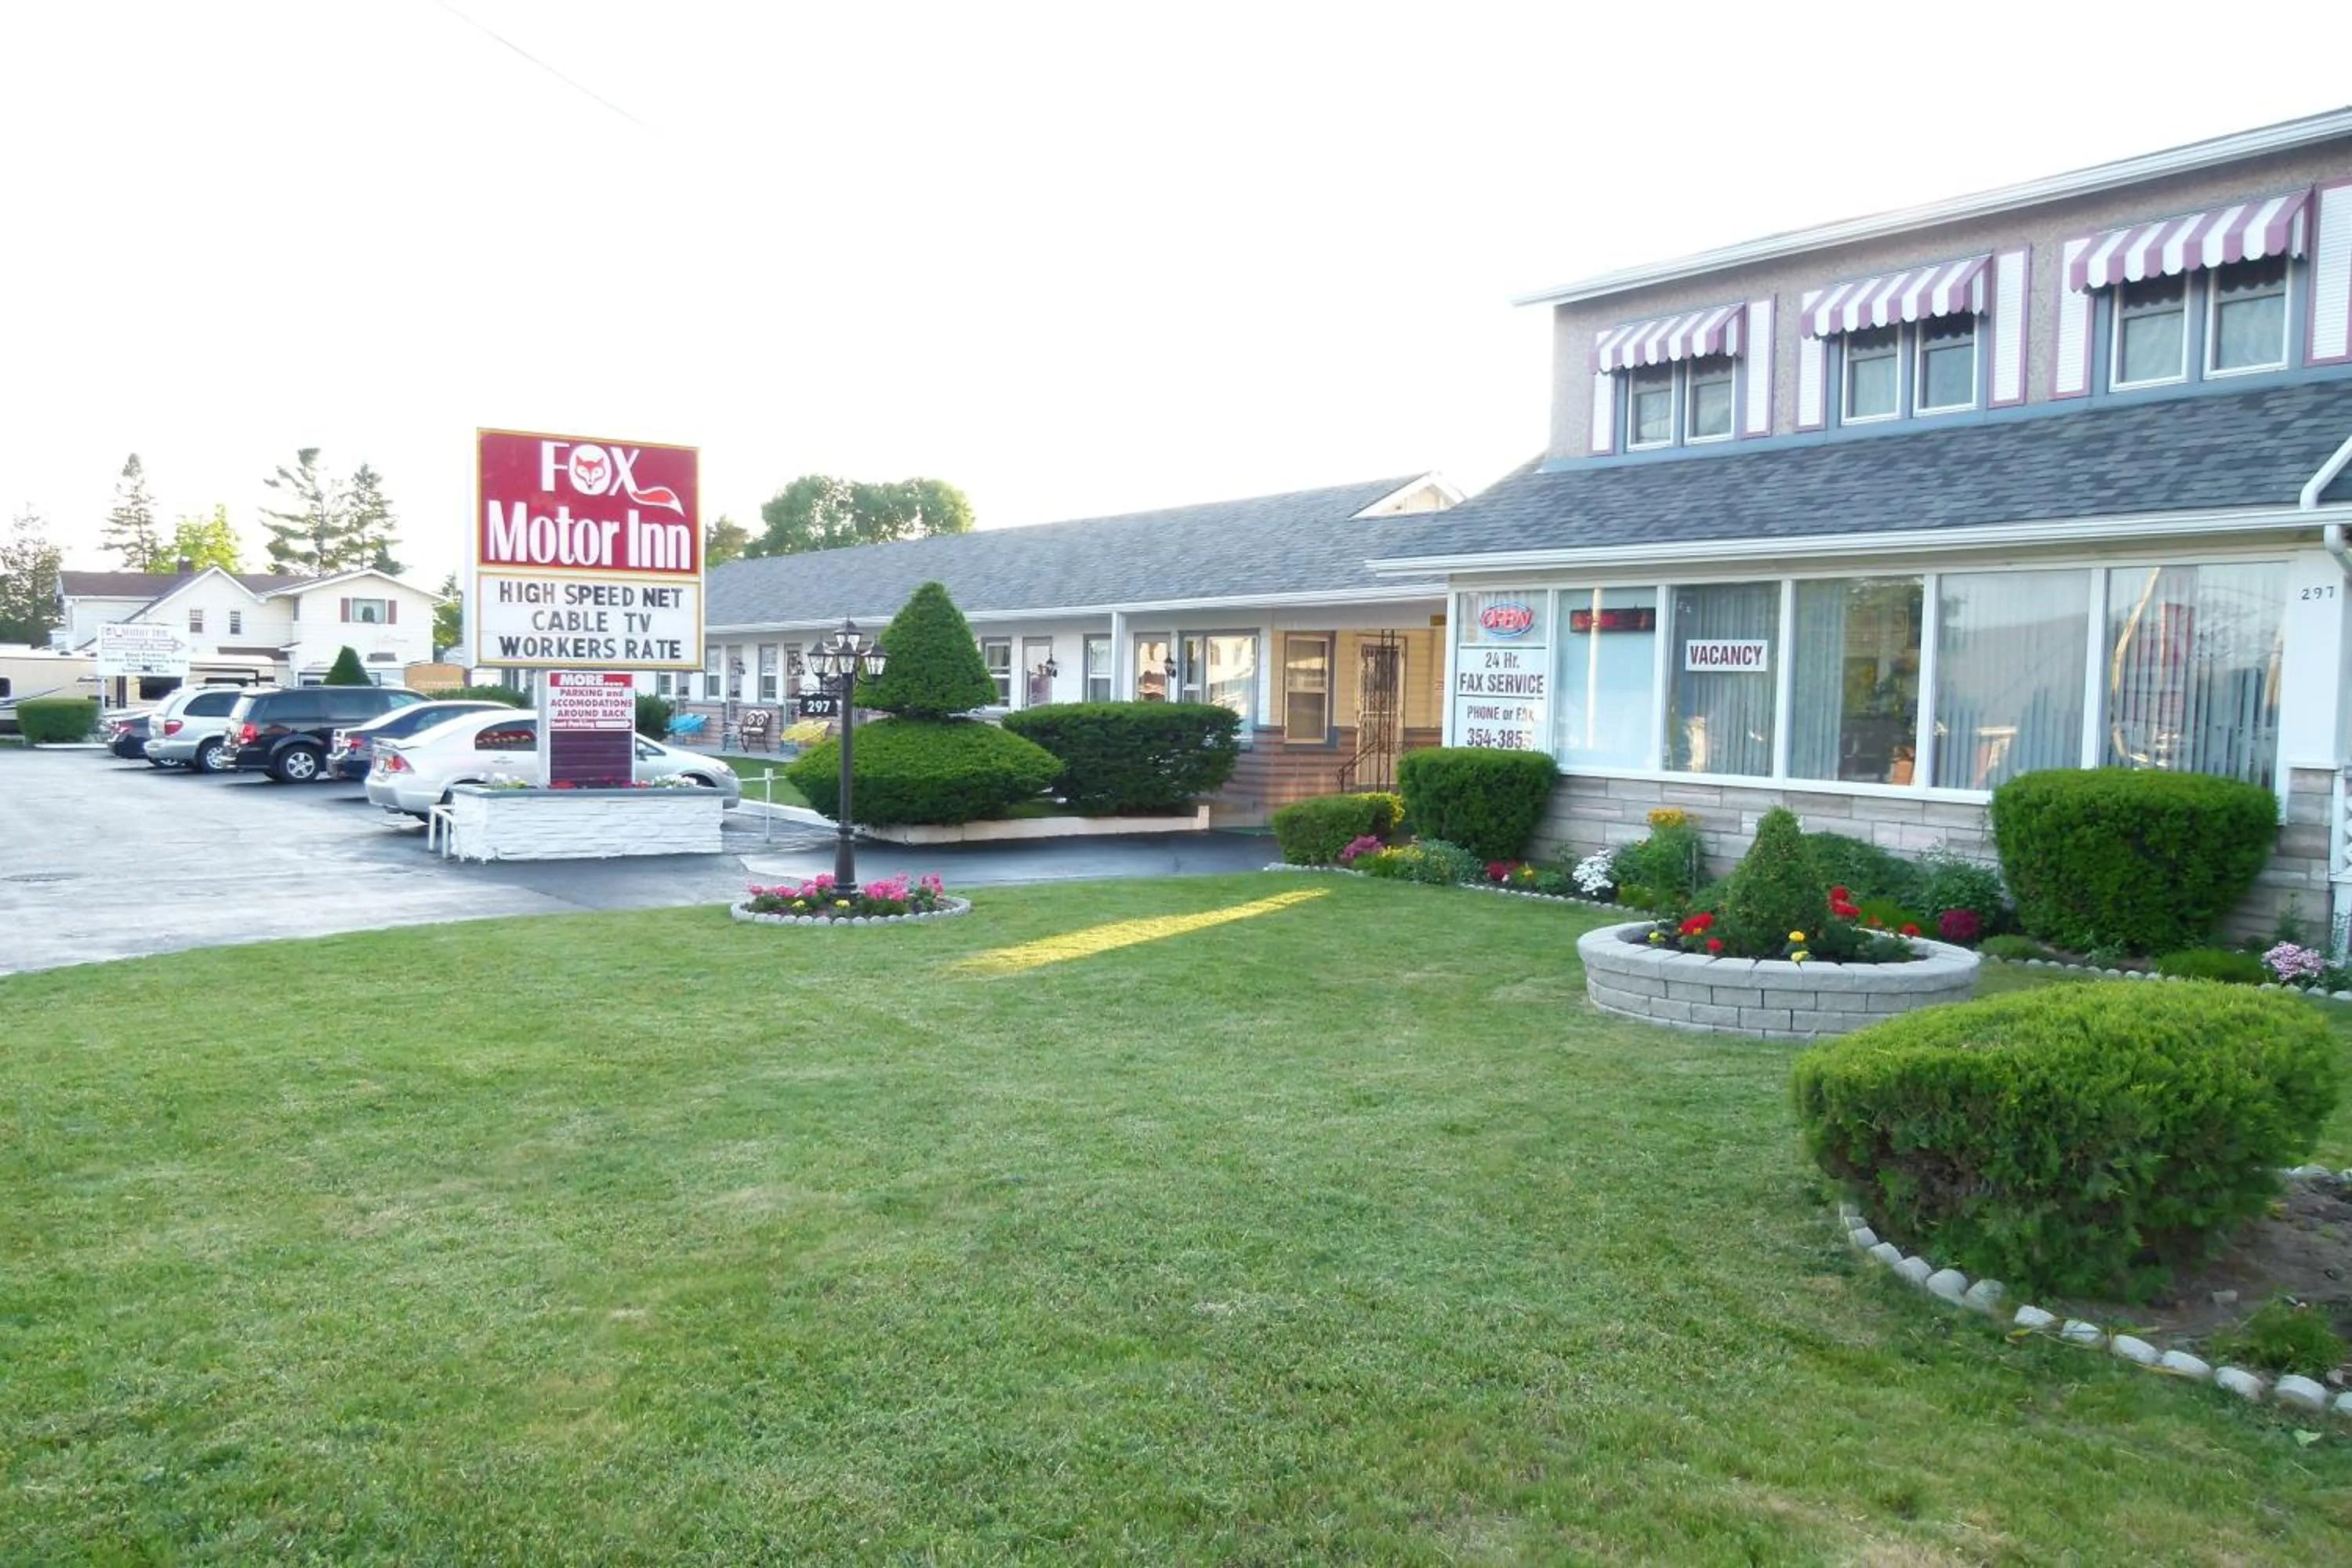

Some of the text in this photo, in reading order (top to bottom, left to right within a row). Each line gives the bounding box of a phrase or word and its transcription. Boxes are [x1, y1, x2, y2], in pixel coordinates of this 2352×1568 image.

[541, 440, 648, 500] FOX
[487, 499, 691, 570] Motor Inn
[499, 581, 683, 608] HIGH SPEED NET
[2301, 586, 2334, 600] 297
[532, 611, 652, 633] CABLE TV
[499, 637, 682, 659] WORKERS RATE
[1690, 646, 1763, 666] VACANCY
[1485, 652, 1520, 668] 24 Hr.
[559, 688, 603, 697] PARKING
[1460, 673, 1544, 694] FAX SERVICE
[551, 699, 633, 707] ACCOMODATIONS
[808, 700, 830, 713] 297
[1467, 706, 1499, 720] PHONE
[1502, 710, 1513, 720] or
